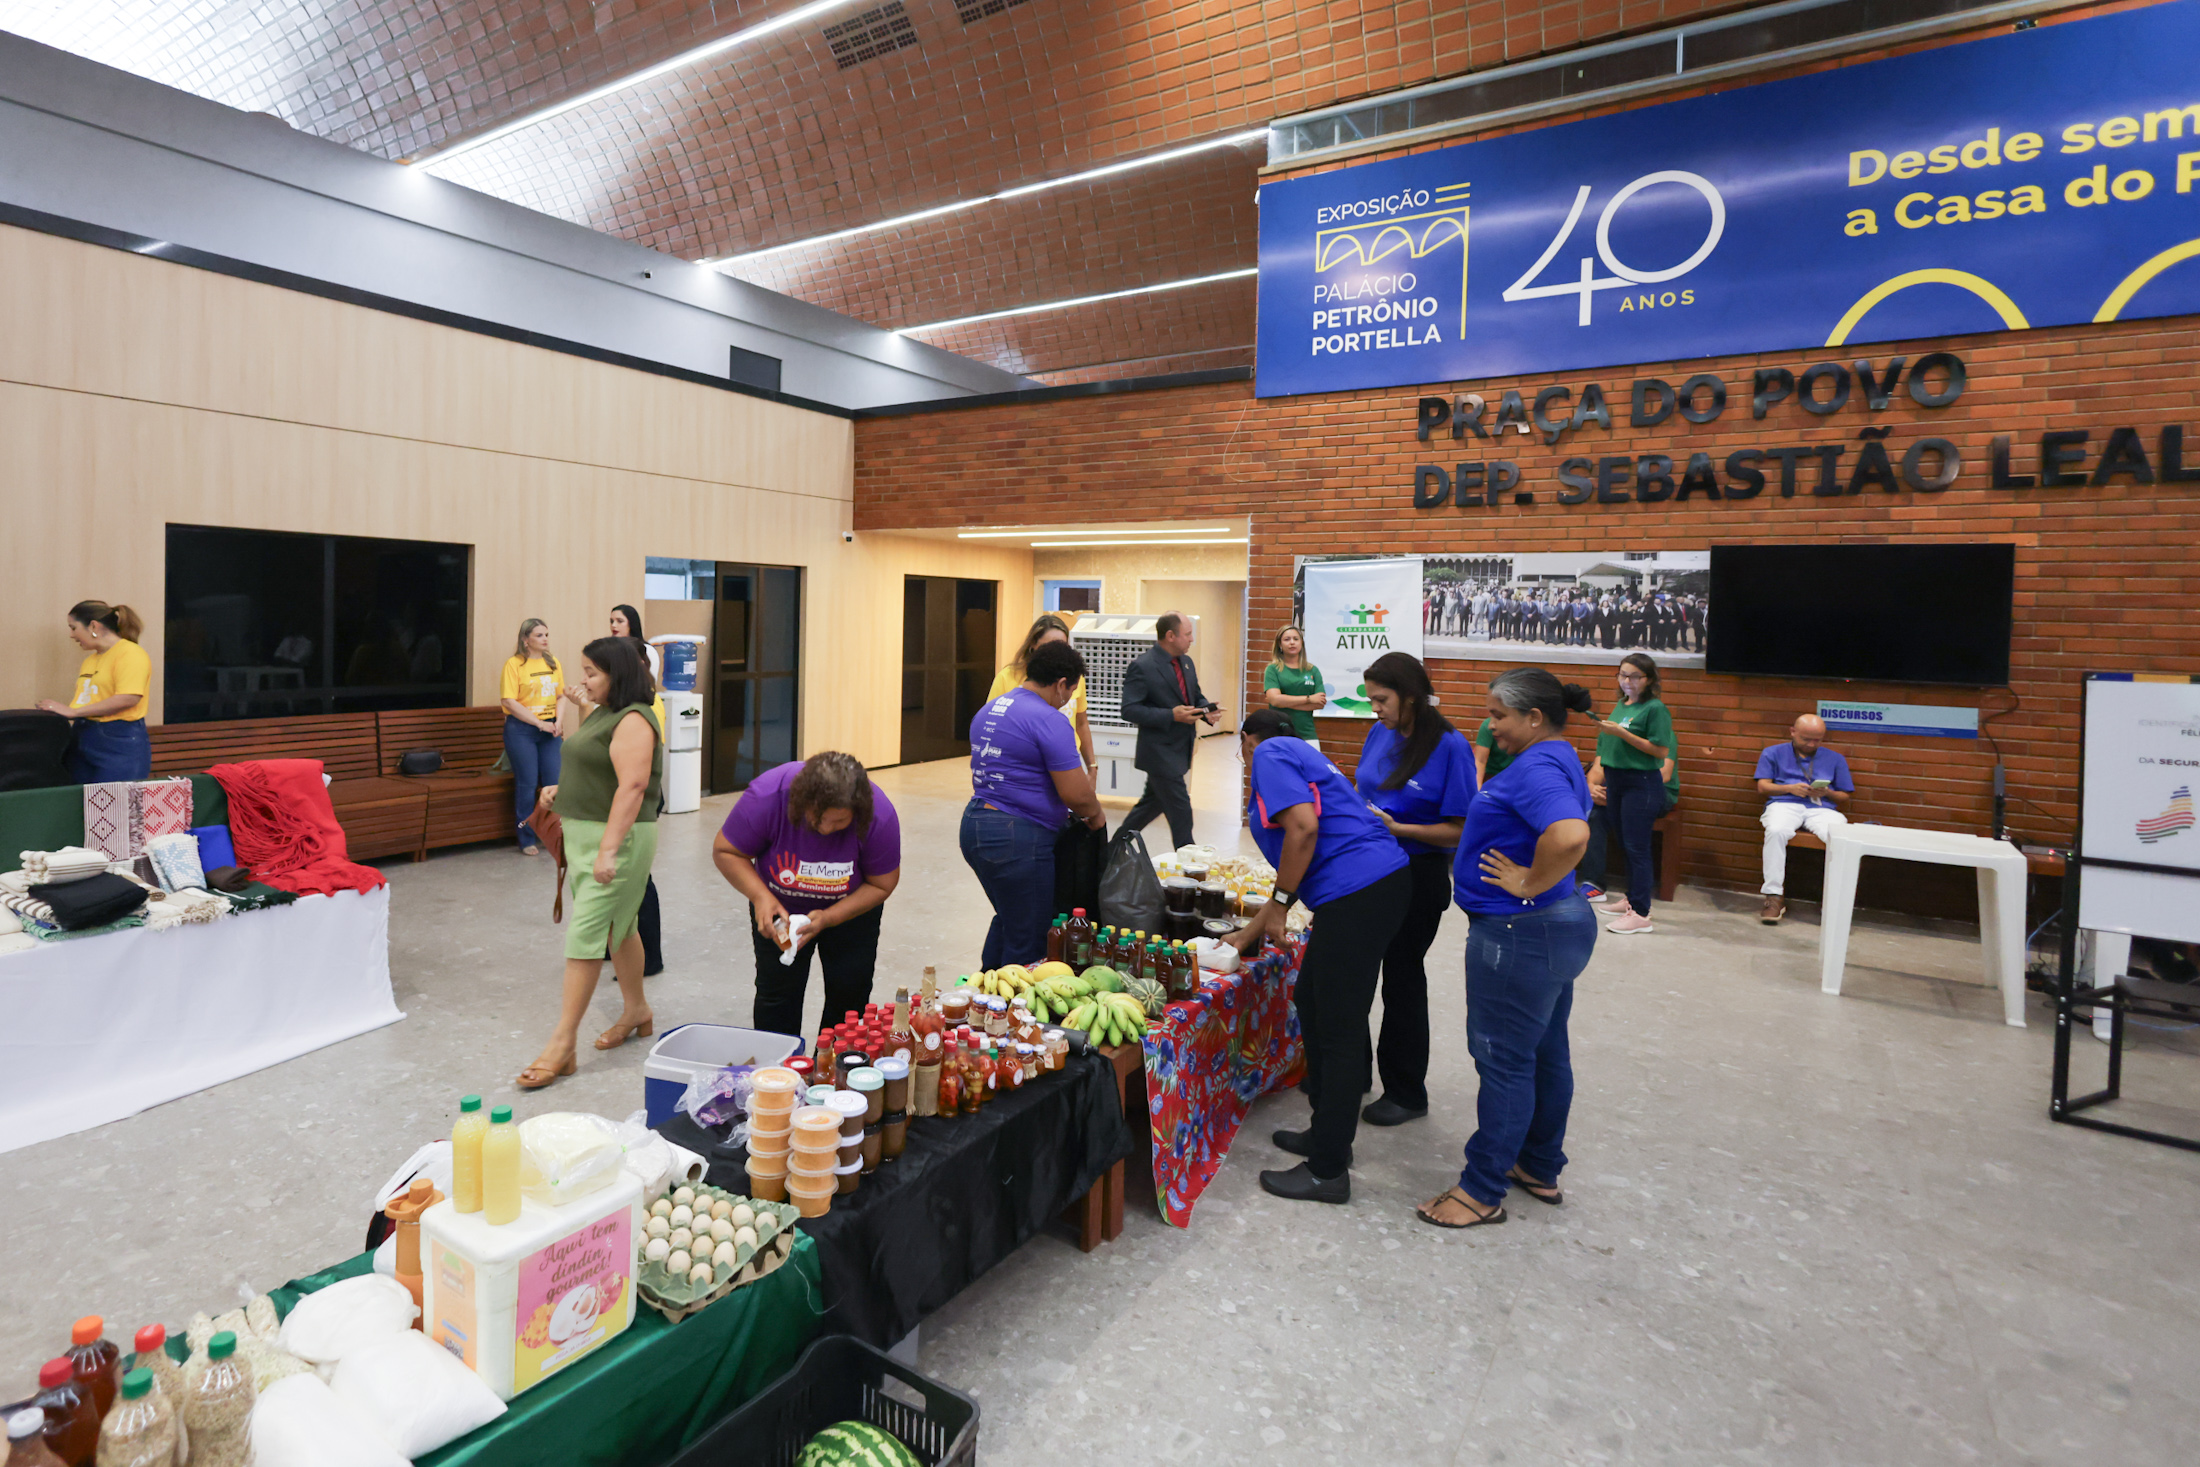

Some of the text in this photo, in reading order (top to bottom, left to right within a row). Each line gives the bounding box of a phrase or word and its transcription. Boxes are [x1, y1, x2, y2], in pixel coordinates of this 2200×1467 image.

[1848, 127, 2043, 187] Desde
[1317, 188, 1430, 224] EXPOSIÇÃO
[1844, 208, 1878, 237] a
[1894, 184, 2046, 229] Casa
[2064, 164, 2155, 208] do
[1502, 170, 1726, 327] 40
[1314, 272, 1417, 304] PALÁCIO
[1619, 289, 1695, 313] ANOS
[1312, 296, 1438, 330] PETRÔNIO
[1312, 323, 1442, 356] PORTELLA
[1418, 352, 1966, 446] PRAÇA DO POVO
[1413, 424, 2200, 509] DEP. SEBASTIÃO LEAL
[1336, 634, 1390, 649] ATIVA
[1820, 708, 1883, 721] DISCURSOS
[2139, 756, 2200, 767] DA SEGUR
[539, 1221, 619, 1272] Aqui tem
[546, 1250, 612, 1306] gourmet!
[551, 1248, 604, 1283] dindin
